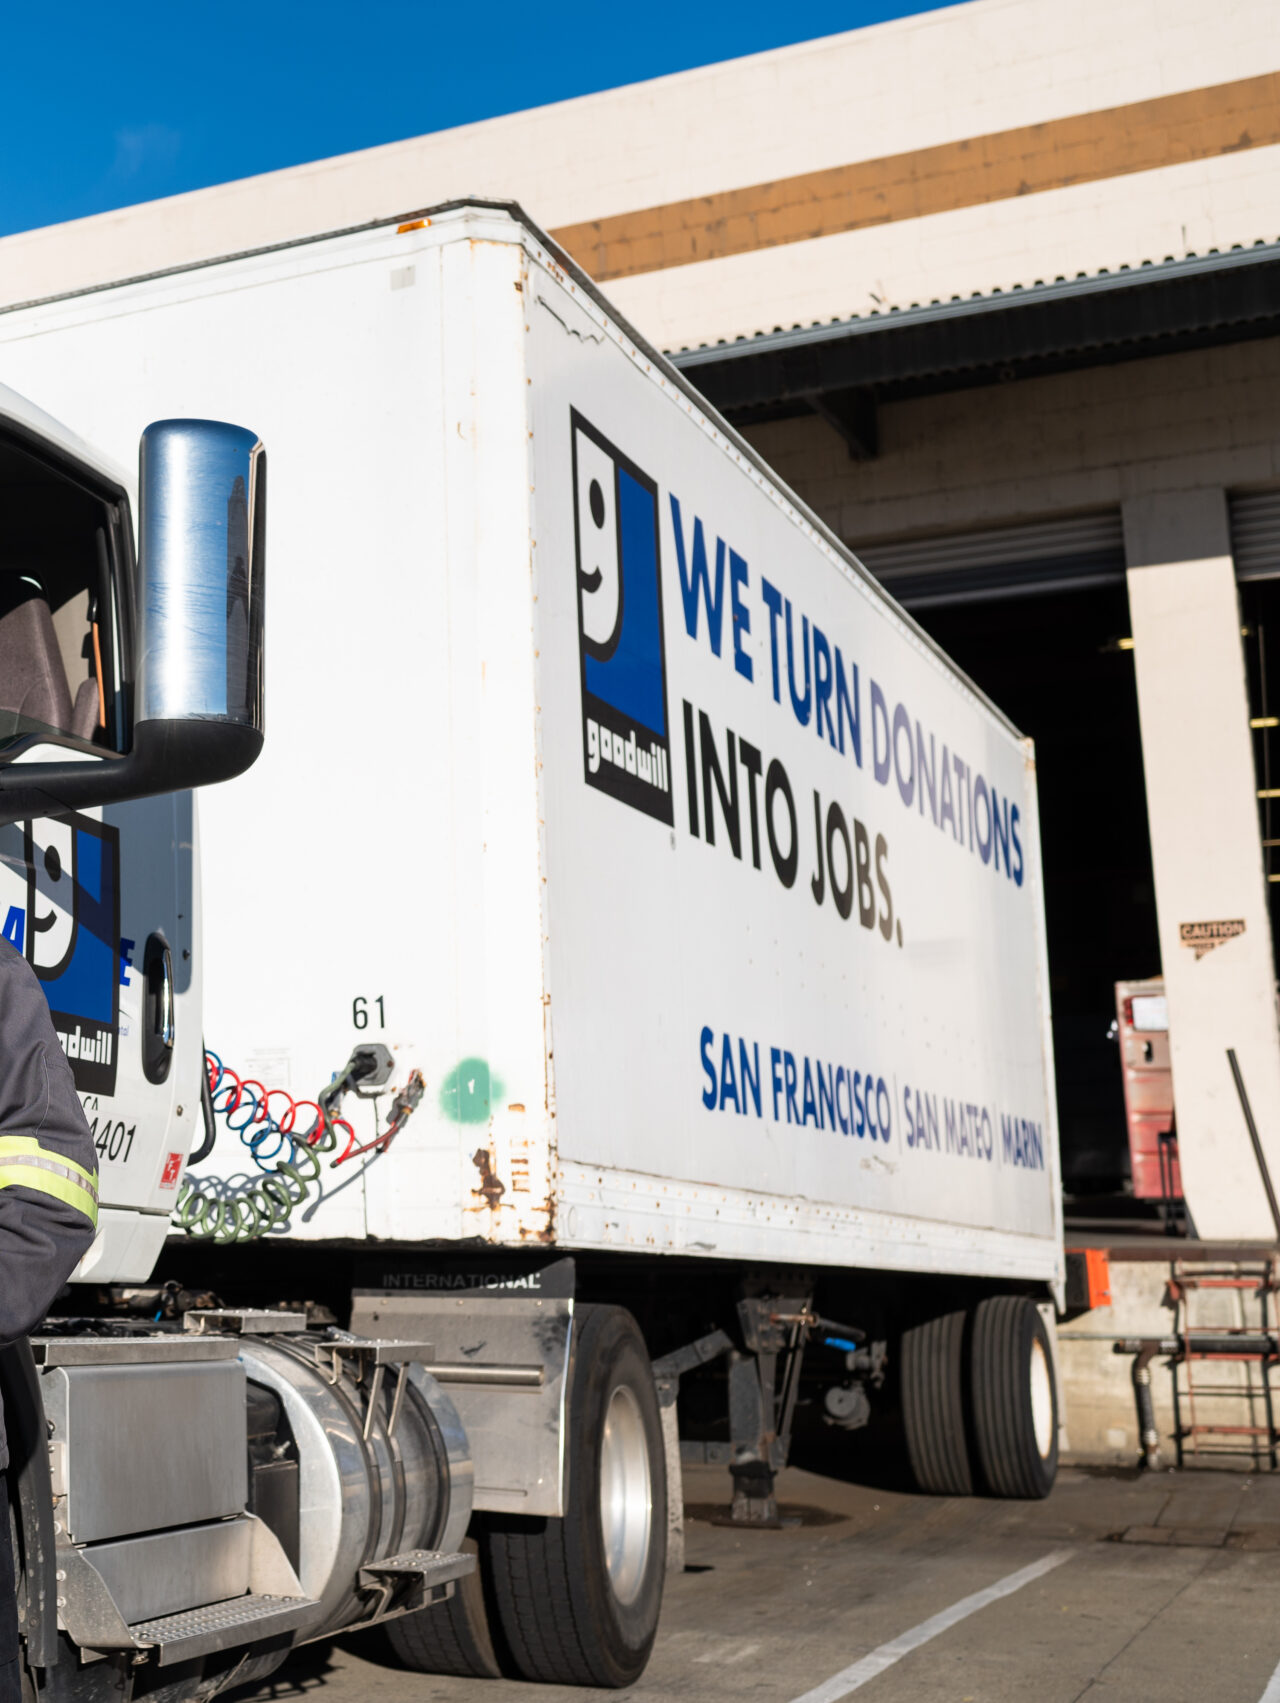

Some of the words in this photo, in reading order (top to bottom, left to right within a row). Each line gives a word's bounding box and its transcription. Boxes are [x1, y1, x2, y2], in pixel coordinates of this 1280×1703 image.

[669, 491, 754, 684] WE
[762, 575, 863, 769] TURN
[870, 677, 1024, 888] DONATIONS
[586, 717, 669, 793] goodwill
[682, 698, 799, 889] INTO
[811, 789, 903, 949] JOBS.
[1182, 921, 1245, 939] CAUTION
[352, 995, 385, 1030] 61
[700, 1026, 762, 1118] SAN
[770, 1046, 891, 1143] FRANCISCO
[904, 1085, 941, 1151] SAN
[944, 1097, 993, 1162] MATEO
[1001, 1113, 1045, 1171] MARIN
[382, 1273, 542, 1289] INTERNATIONAL
